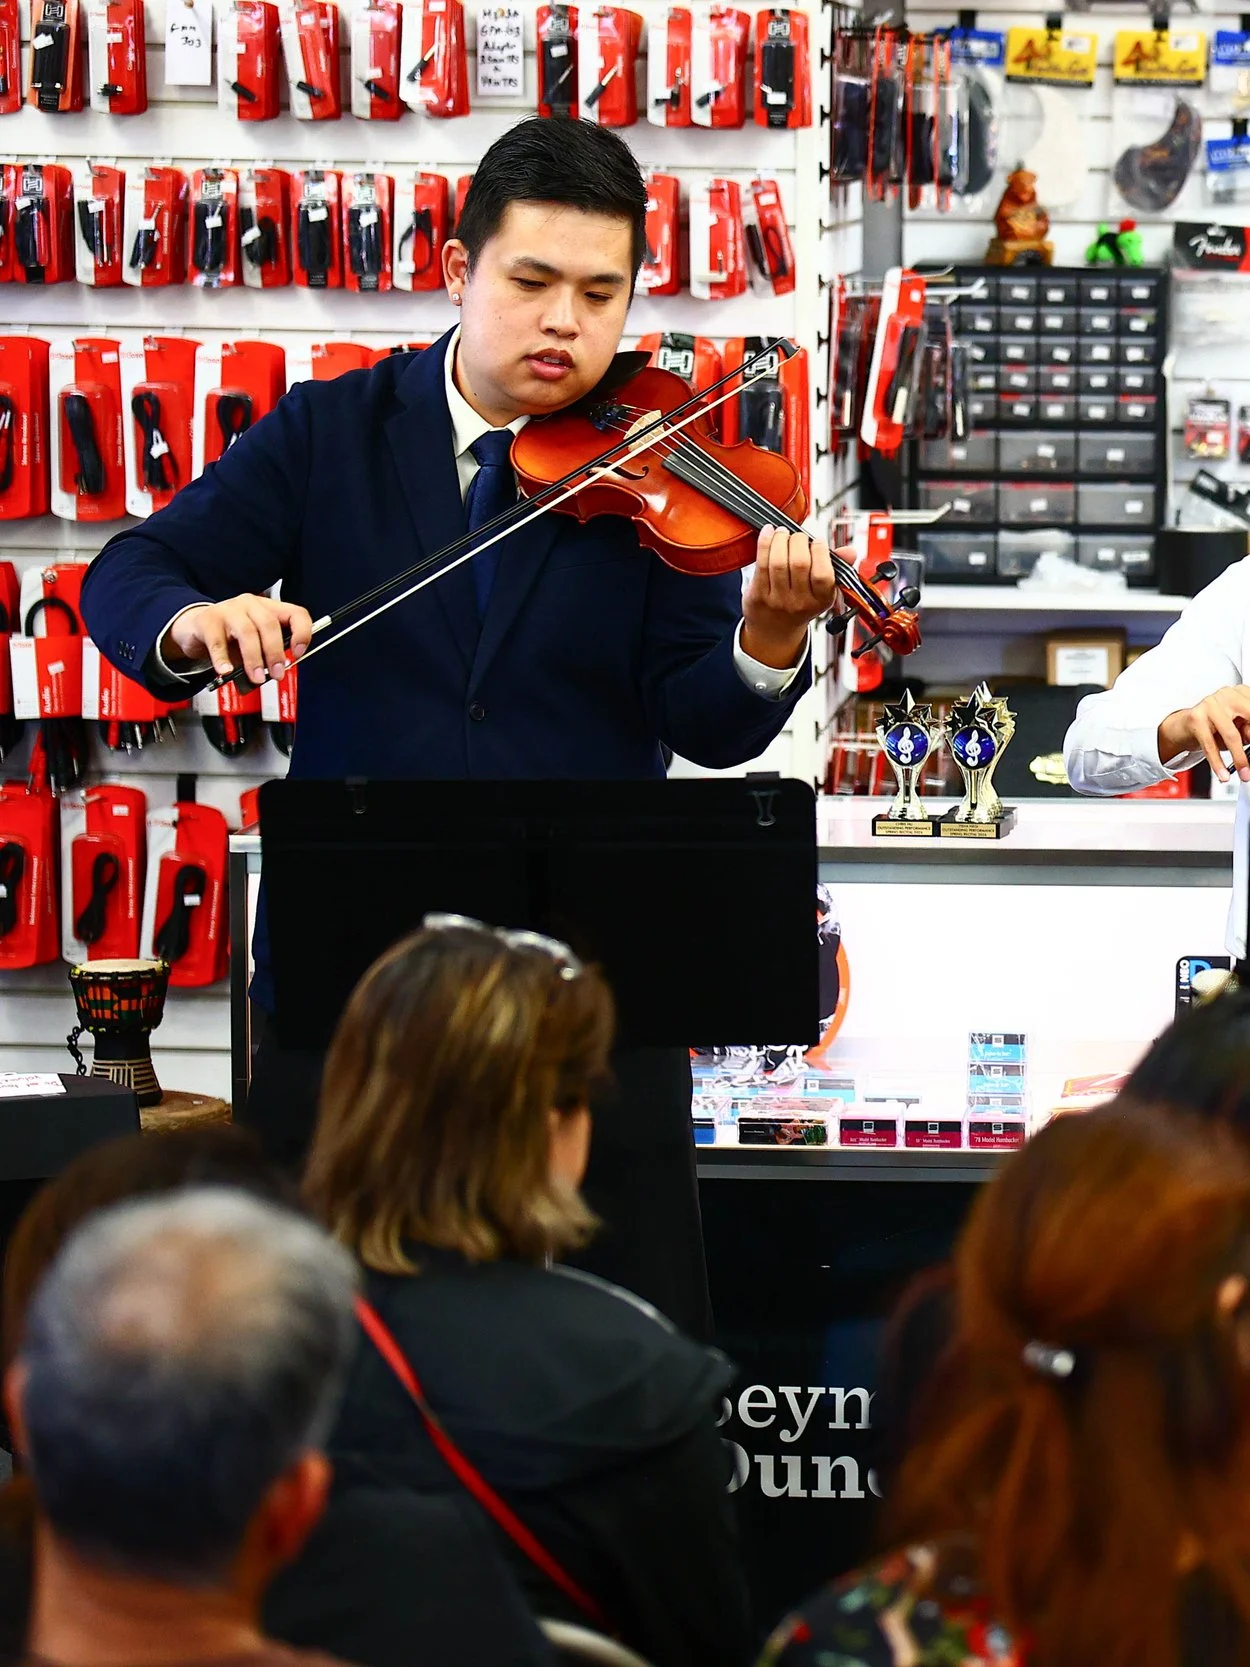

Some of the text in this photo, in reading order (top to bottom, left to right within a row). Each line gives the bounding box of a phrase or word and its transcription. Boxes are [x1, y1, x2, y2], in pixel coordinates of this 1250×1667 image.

[1188, 234, 1241, 258] Fender
[41, 686, 51, 714] Audio
[101, 688, 110, 716] Audio
[220, 685, 230, 712] Audio
[1180, 959, 1190, 983] NEO
[714, 1384, 877, 1443] eym
